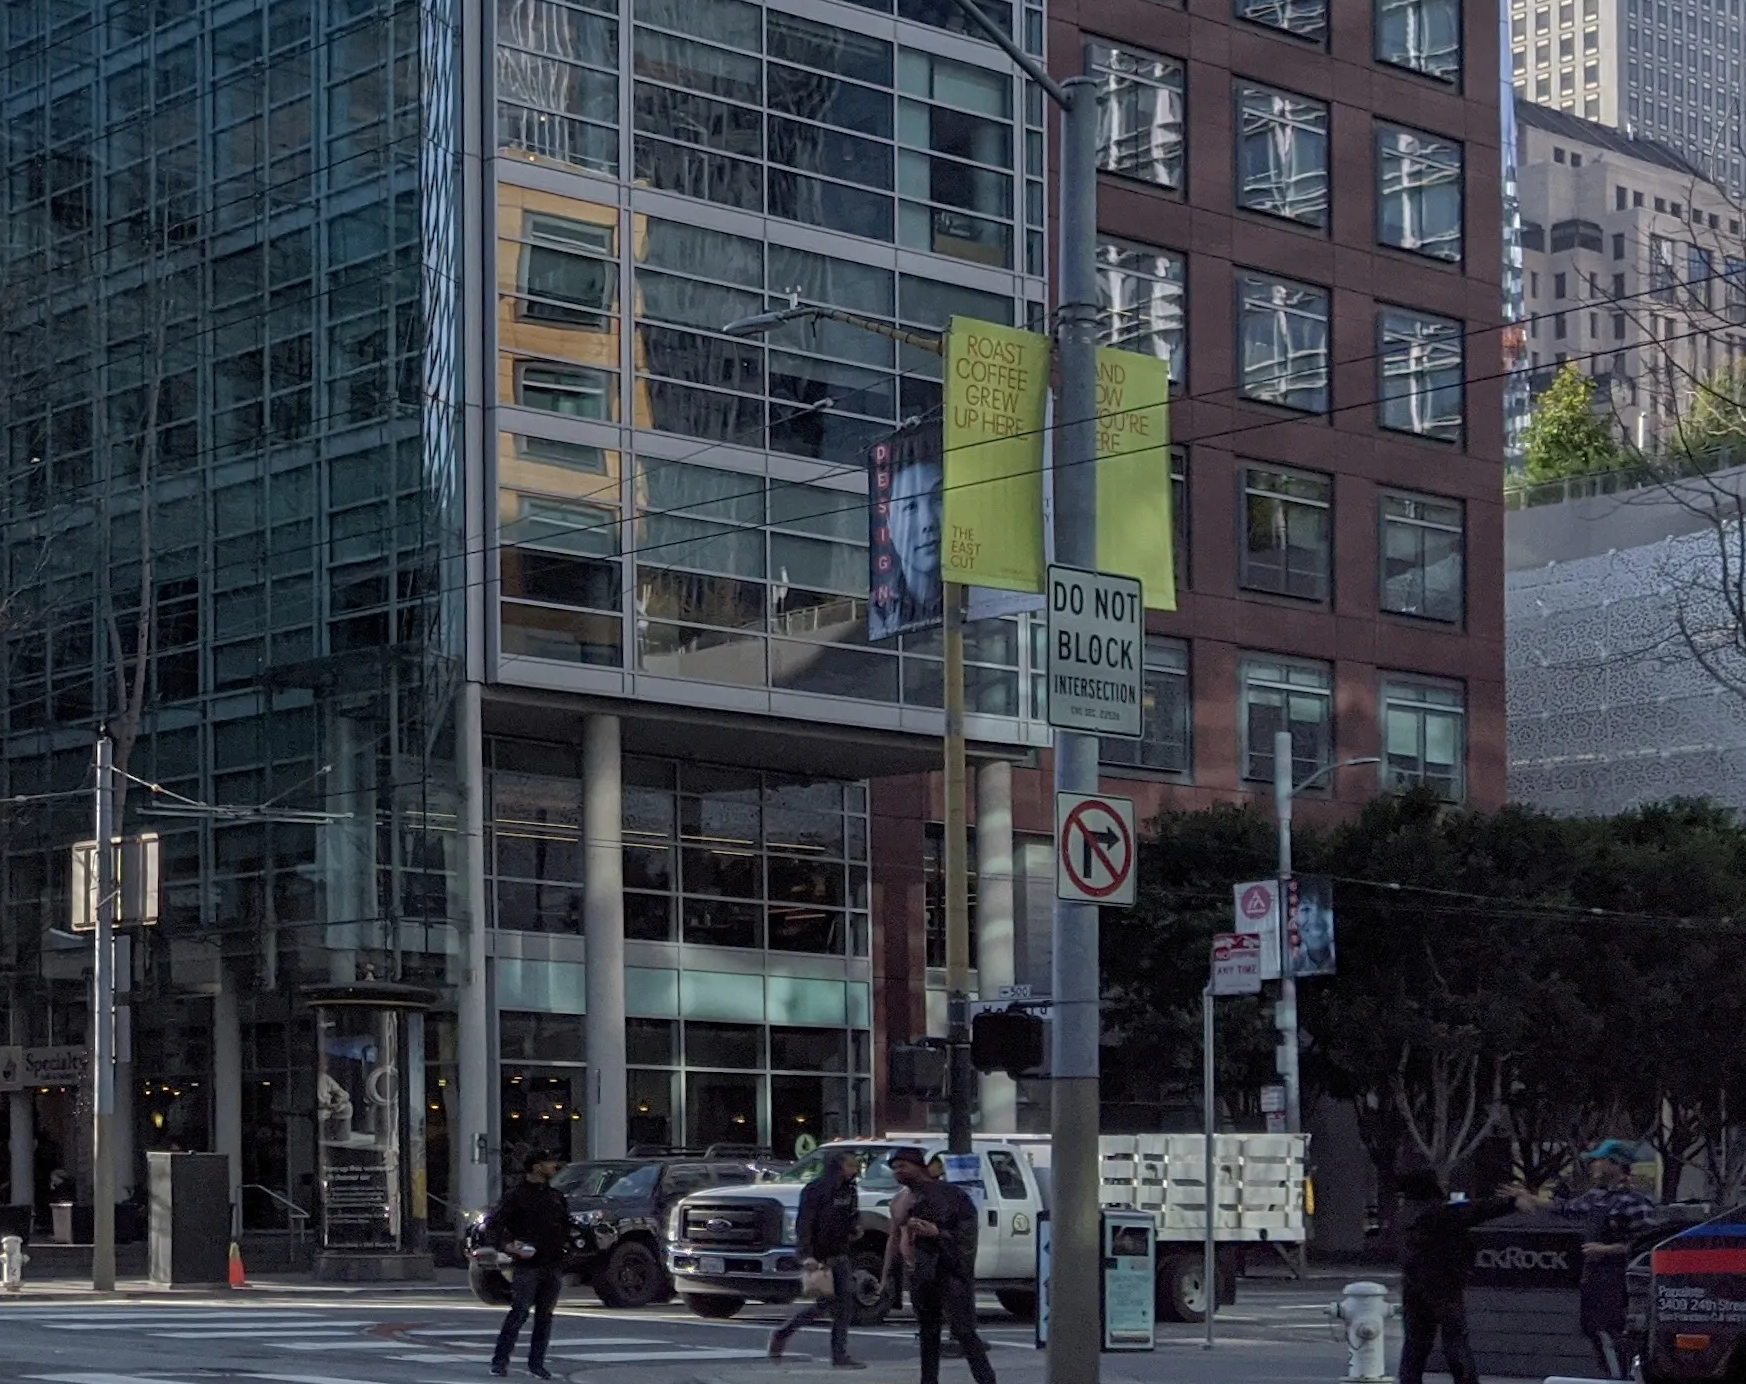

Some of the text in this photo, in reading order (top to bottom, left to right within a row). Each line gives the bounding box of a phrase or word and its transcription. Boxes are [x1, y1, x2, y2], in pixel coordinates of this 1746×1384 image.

[967, 335, 1025, 365] ROAST
[956, 357, 1028, 392] COFFEE
[965, 384, 1018, 414] GREW
[1095, 383, 1123, 407] OW
[954, 405, 1028, 441] UP HERE
[1096, 408, 1150, 436] OU'RE
[876, 446, 889, 601] DESIGN
[952, 525, 974, 541] THE
[950, 555, 974, 569] CUT
[951, 540, 981, 557] EAST
[1054, 581, 1138, 624] DO NOT
[1058, 629, 1133, 671] BLOCK
[1054, 674, 1136, 705] INTERSECTION
